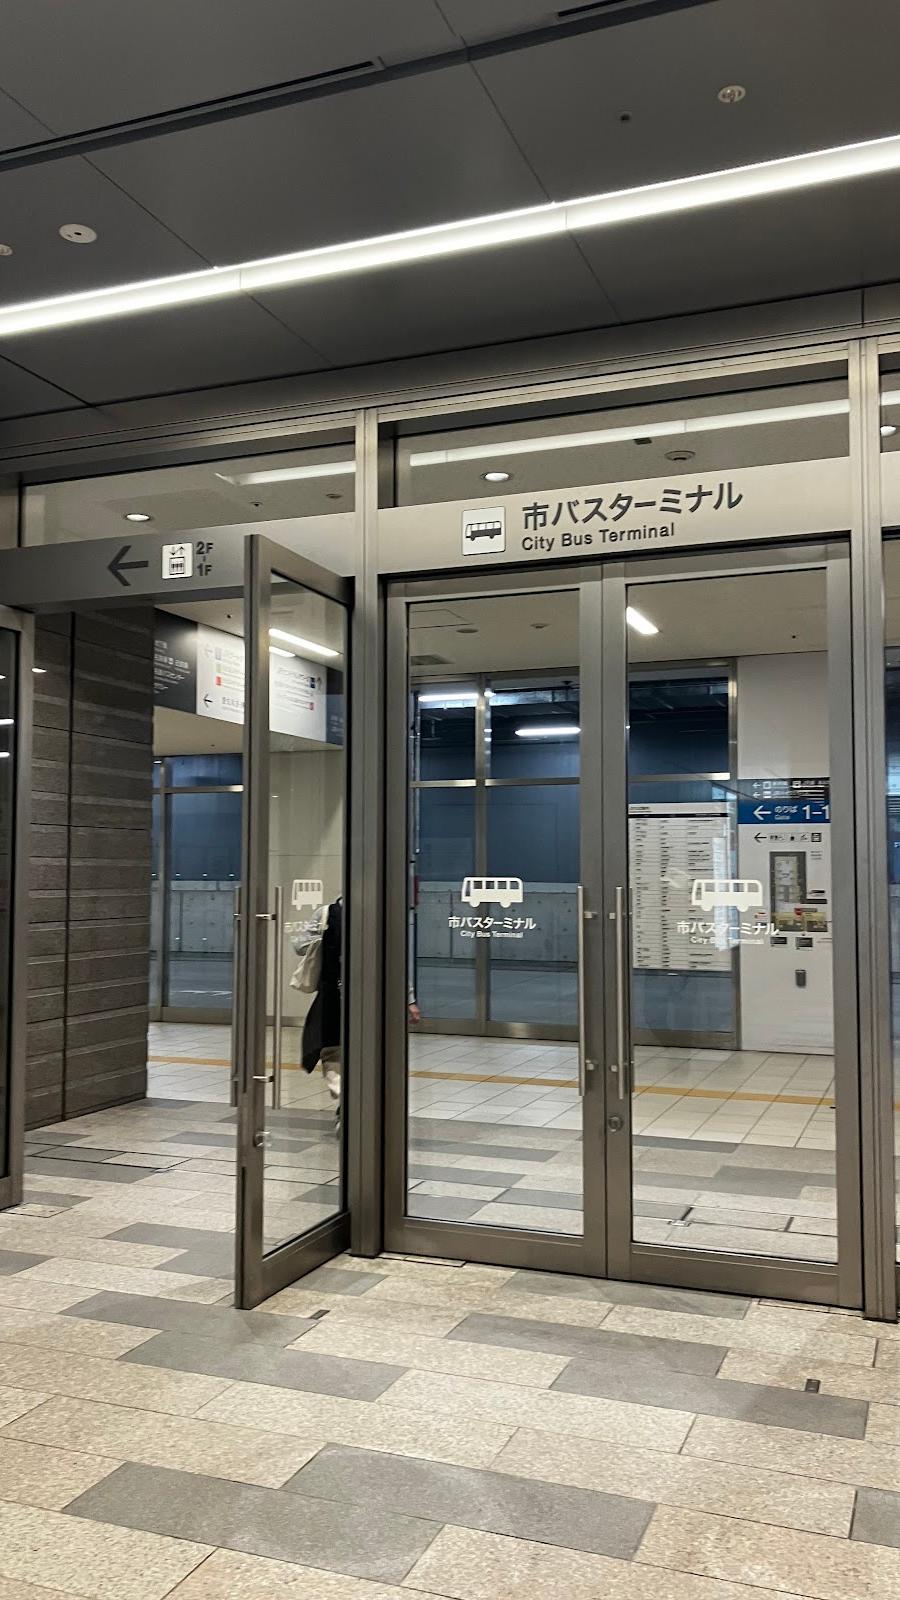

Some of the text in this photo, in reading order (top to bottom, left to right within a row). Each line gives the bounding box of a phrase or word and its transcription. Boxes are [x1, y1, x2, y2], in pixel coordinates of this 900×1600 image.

[522, 482, 743, 531] 市バスターミナル
[522, 522, 675, 552] City Bus Terminal
[196, 541, 213, 554] 2F
[196, 563, 212, 576] 1F
[447, 916, 536, 929] 市バスターミナル
[677, 921, 779, 935] 市バスターミナル
